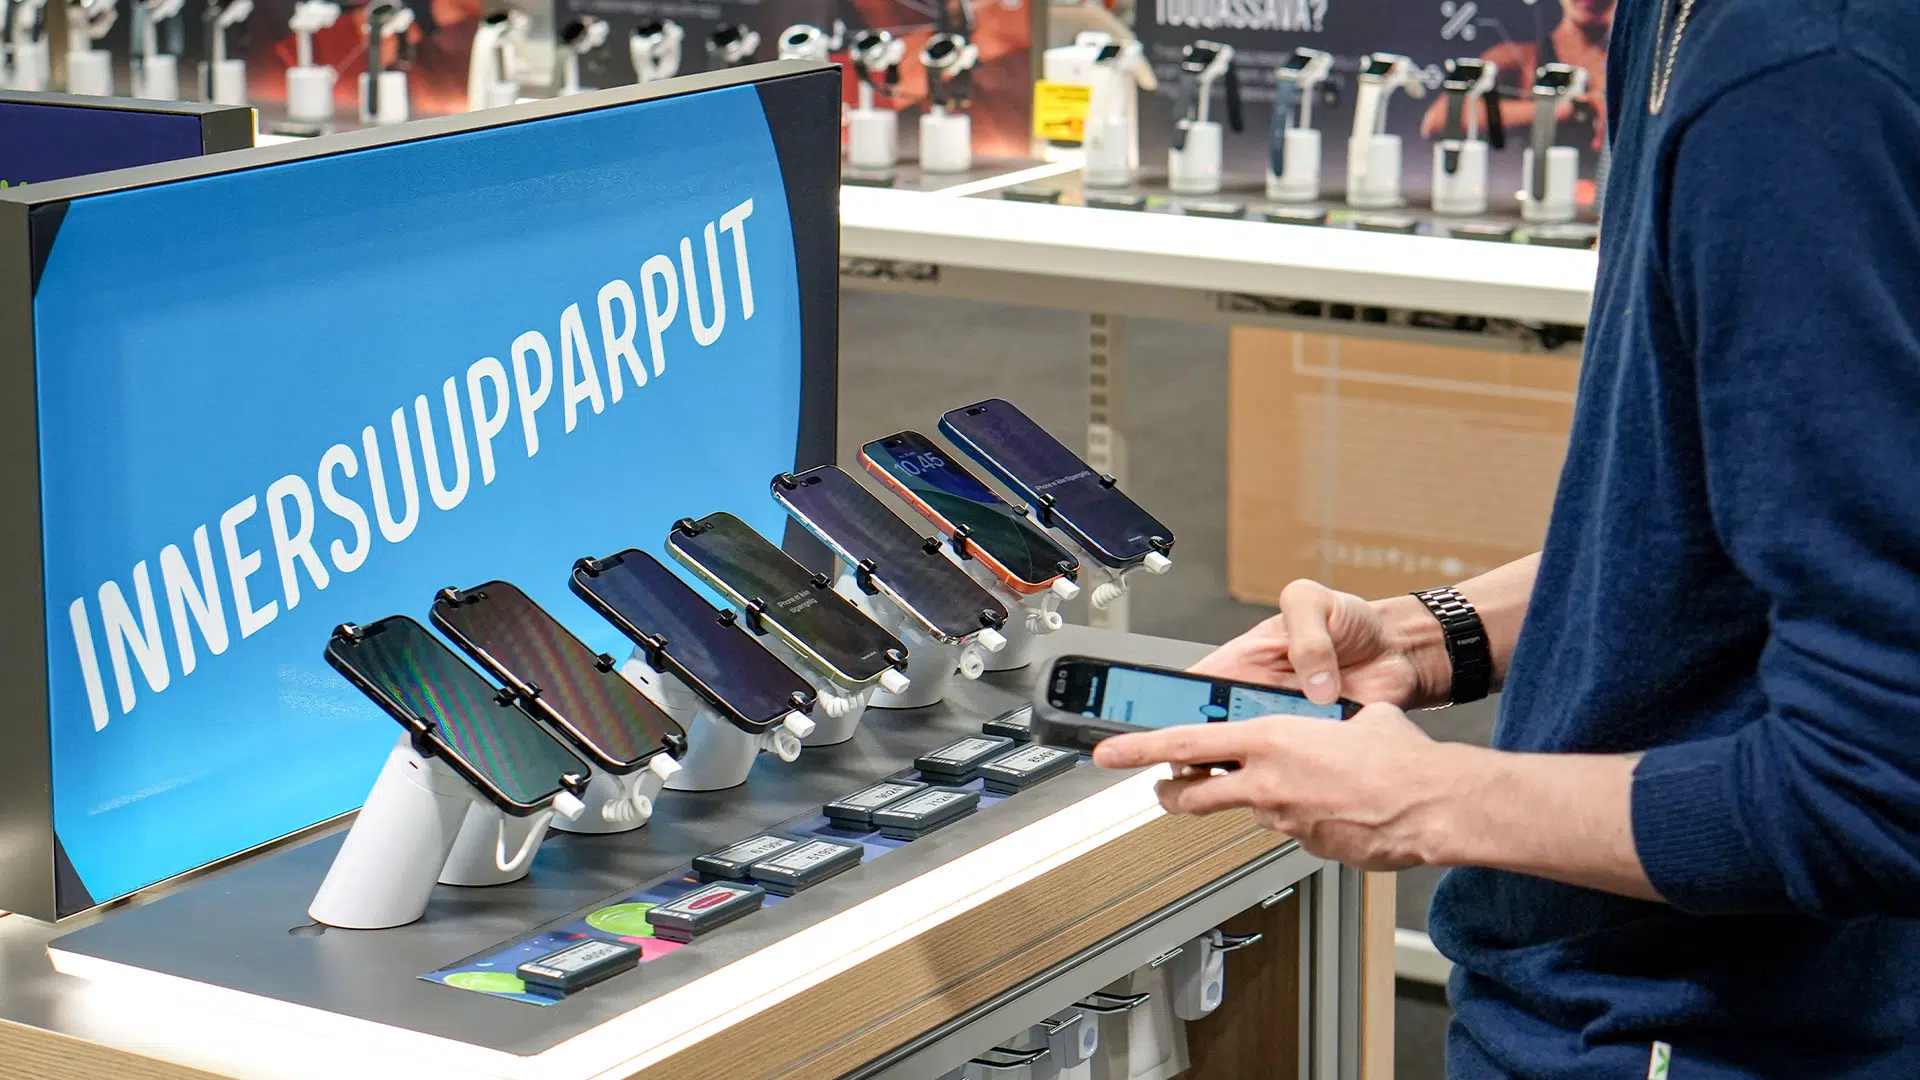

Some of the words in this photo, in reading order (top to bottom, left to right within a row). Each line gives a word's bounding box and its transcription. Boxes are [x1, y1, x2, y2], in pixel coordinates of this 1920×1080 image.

[68, 197, 756, 732] INNERSUUPPARPUT
[893, 451, 945, 477] 10.45
[776, 597, 795, 608] iPhone
